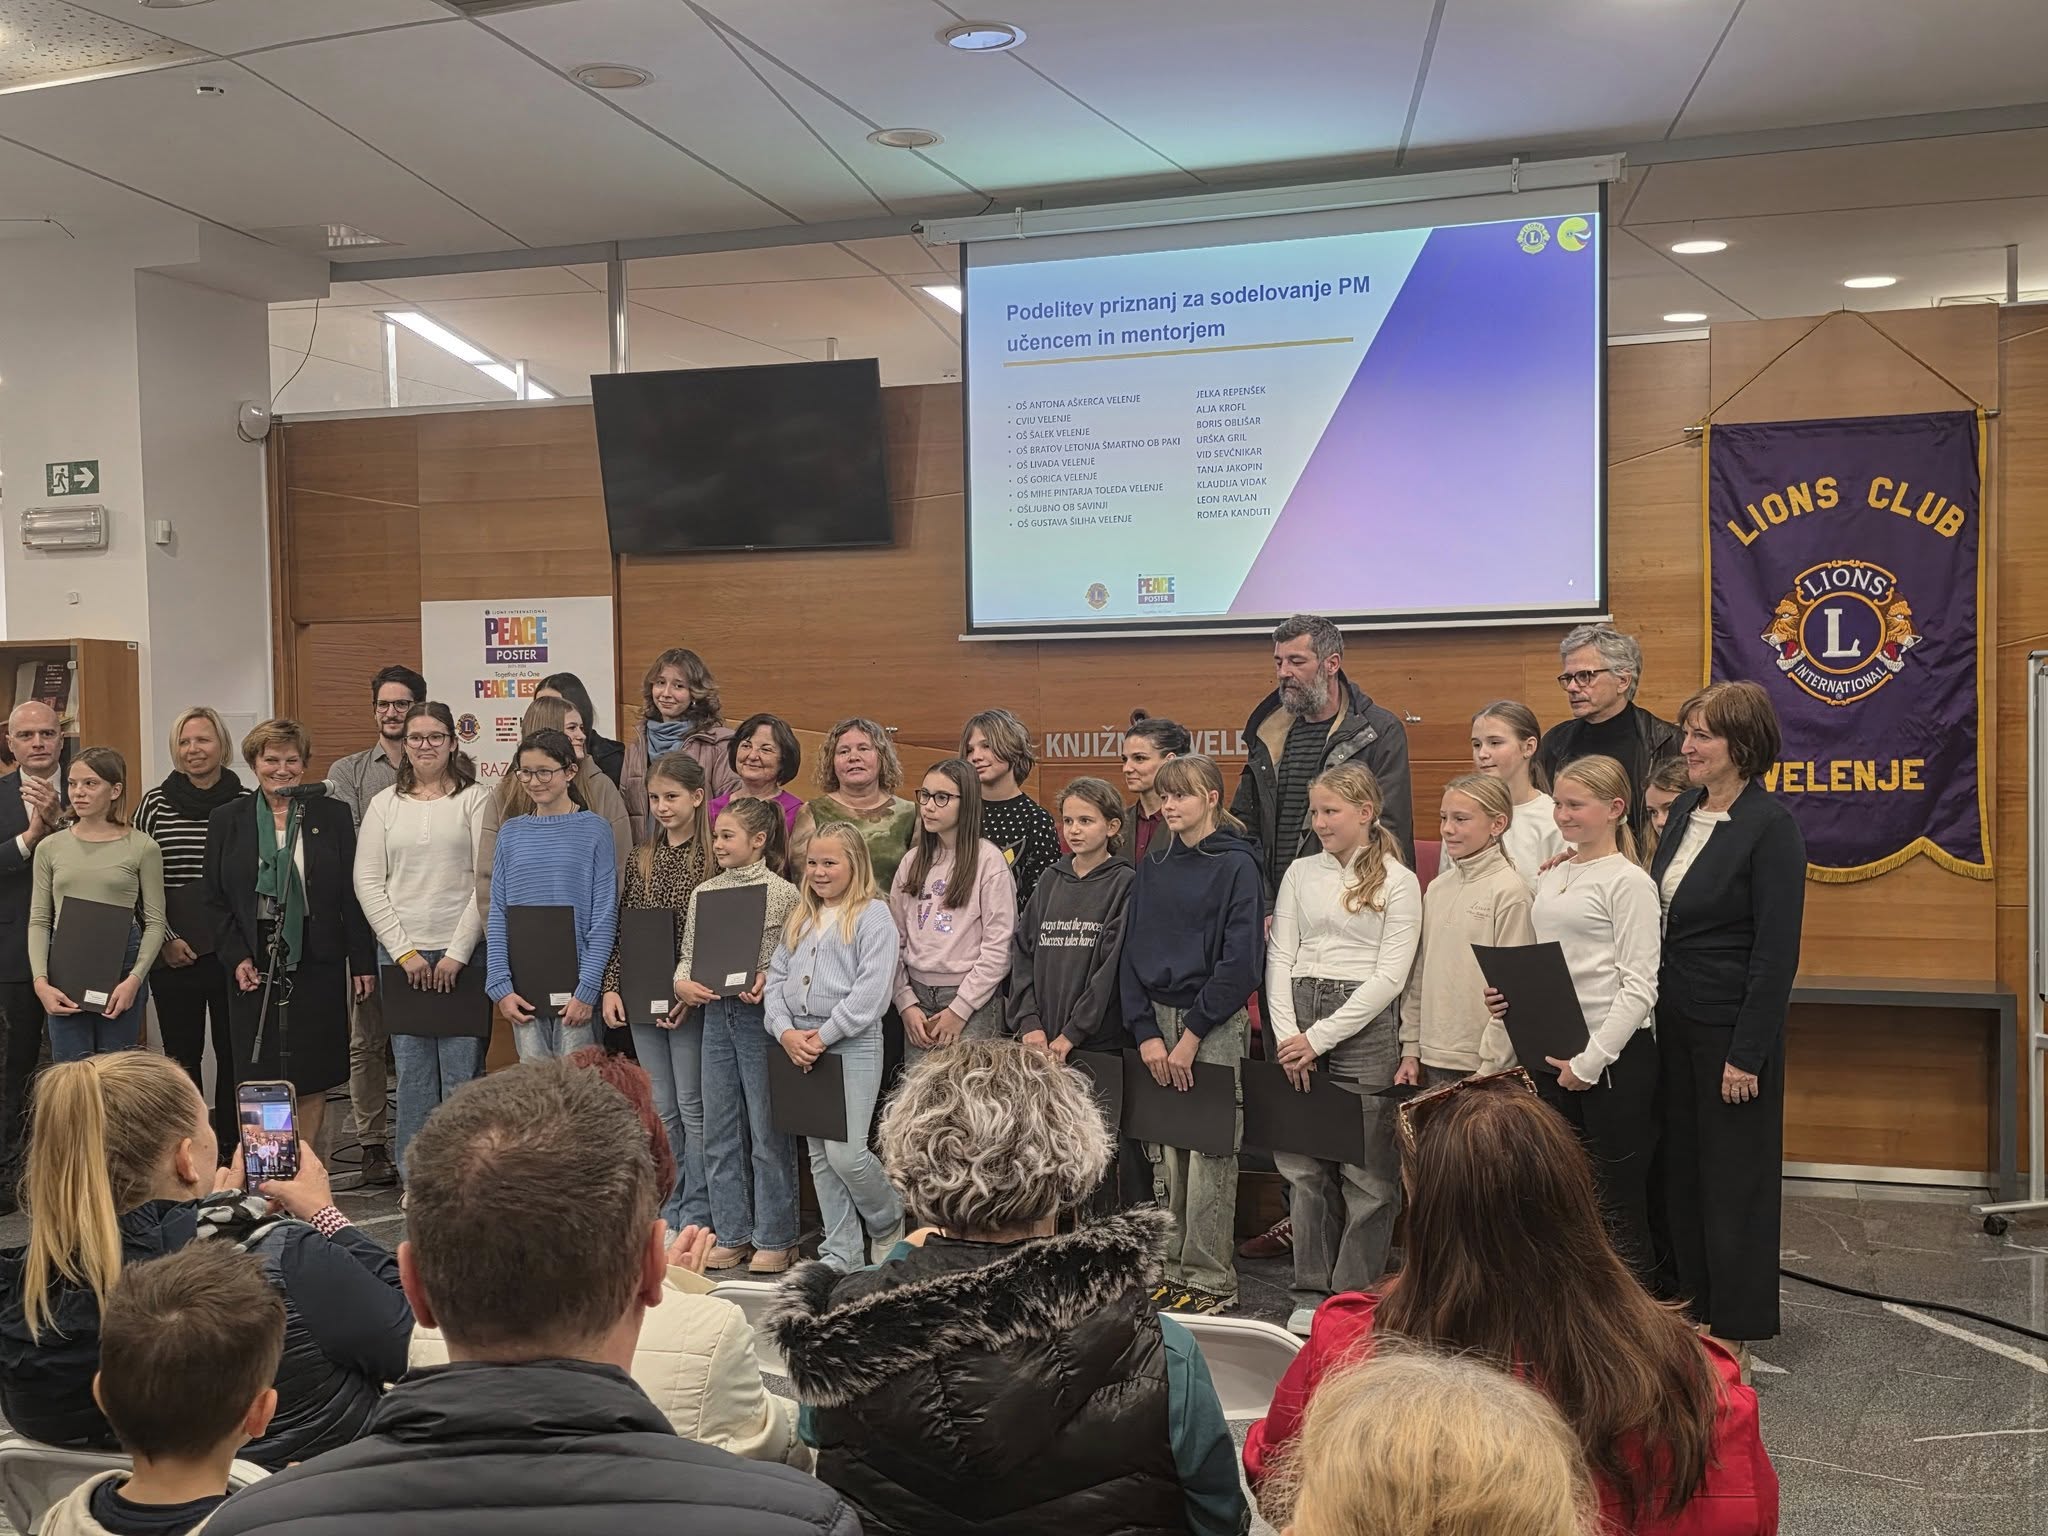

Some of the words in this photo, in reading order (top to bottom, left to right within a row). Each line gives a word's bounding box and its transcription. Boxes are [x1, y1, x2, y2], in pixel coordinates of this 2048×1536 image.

[1524, 224, 1543, 232] LIONS
[1530, 232, 1538, 243] L
[1007, 300, 1093, 321] Podelitev
[1100, 292, 1176, 318] priznanj
[1183, 293, 1204, 307] za
[1211, 280, 1331, 305] sodelovanje
[1339, 276, 1370, 295] PM
[1008, 333, 1091, 351] učencem
[1099, 329, 1114, 345] in
[1122, 322, 1225, 343] mentorjem
[1196, 390, 1220, 398] JELKA
[1223, 386, 1265, 396] REPENŠEK
[1016, 402, 1027, 410] OŠ
[1029, 400, 1065, 409] ANTONA
[1067, 397, 1104, 407] AŠKERCA
[1107, 395, 1141, 404] VELENJE
[1197, 405, 1216, 413] ALJA
[1219, 403, 1246, 412] KROFL
[1016, 417, 1035, 425] CVIU
[1038, 414, 1071, 423] VELENJE
[1197, 420, 1222, 428] BORIS
[1225, 417, 1261, 426] OBLIŠAR
[1016, 431, 1027, 440] OŠ
[1030, 430, 1054, 439] ŠALEK
[1056, 428, 1090, 437] VELENJE
[1197, 435, 1224, 444] URŠKA
[1228, 434, 1247, 442] GRIL
[1016, 446, 1027, 455] OŠ
[1030, 444, 1062, 454] BRATOV
[1065, 442, 1100, 452] LETONJA
[1103, 439, 1144, 449] ŠMARTNO
[1147, 438, 1159, 447] OB
[1162, 437, 1181, 446] PAKI
[1197, 450, 1211, 458] VID
[1017, 460, 1027, 469] OŠ
[1031, 459, 1059, 469] LIVADA
[1062, 458, 1095, 466] VELENJE
[1197, 465, 1223, 474] TANJA
[1226, 463, 1262, 472] JAKOPIN
[1017, 475, 1028, 484] OŠ
[1031, 474, 1062, 483] GORICA
[1064, 472, 1097, 481] VELENJE
[1197, 480, 1237, 488] KLAUDIJA
[1241, 478, 1267, 486] VIDAK
[1017, 490, 1028, 498] OŠ
[1031, 490, 1052, 498] MIHE
[1054, 487, 1092, 497] PINTARJA
[1095, 485, 1127, 494] TOLEDA
[1129, 483, 1163, 492] VELENJE
[1197, 496, 1219, 504] LEON
[1222, 494, 1257, 503] RAVLAN
[1077, 502, 1108, 511] SAVINJI
[1727, 476, 1839, 547] LIONS
[1868, 476, 1965, 538] CLUB
[1197, 511, 1228, 519] ROMEA
[1231, 508, 1271, 517] KANDUTI
[1018, 518, 1028, 527] OŠ
[1031, 517, 1068, 527] GUSTAVA
[1070, 515, 1096, 525] ŠILIHA
[1099, 515, 1132, 524] VELENJE
[1138, 577, 1174, 594] PEACE
[1804, 568, 1888, 597] LIONS
[485, 617, 548, 645] PEACE
[1822, 608, 1861, 657] L
[497, 650, 536, 660] POSTER
[1795, 664, 1887, 693] INTERNATIONAL
[475, 680, 515, 698] PEACE
[1764, 759, 1925, 792] VELENJE
[1057, 920, 1072, 930] trust
[1072, 917, 1081, 930] the
[1039, 933, 1064, 946] Success
[1064, 933, 1079, 946] takes
[1079, 933, 1096, 947] hard
